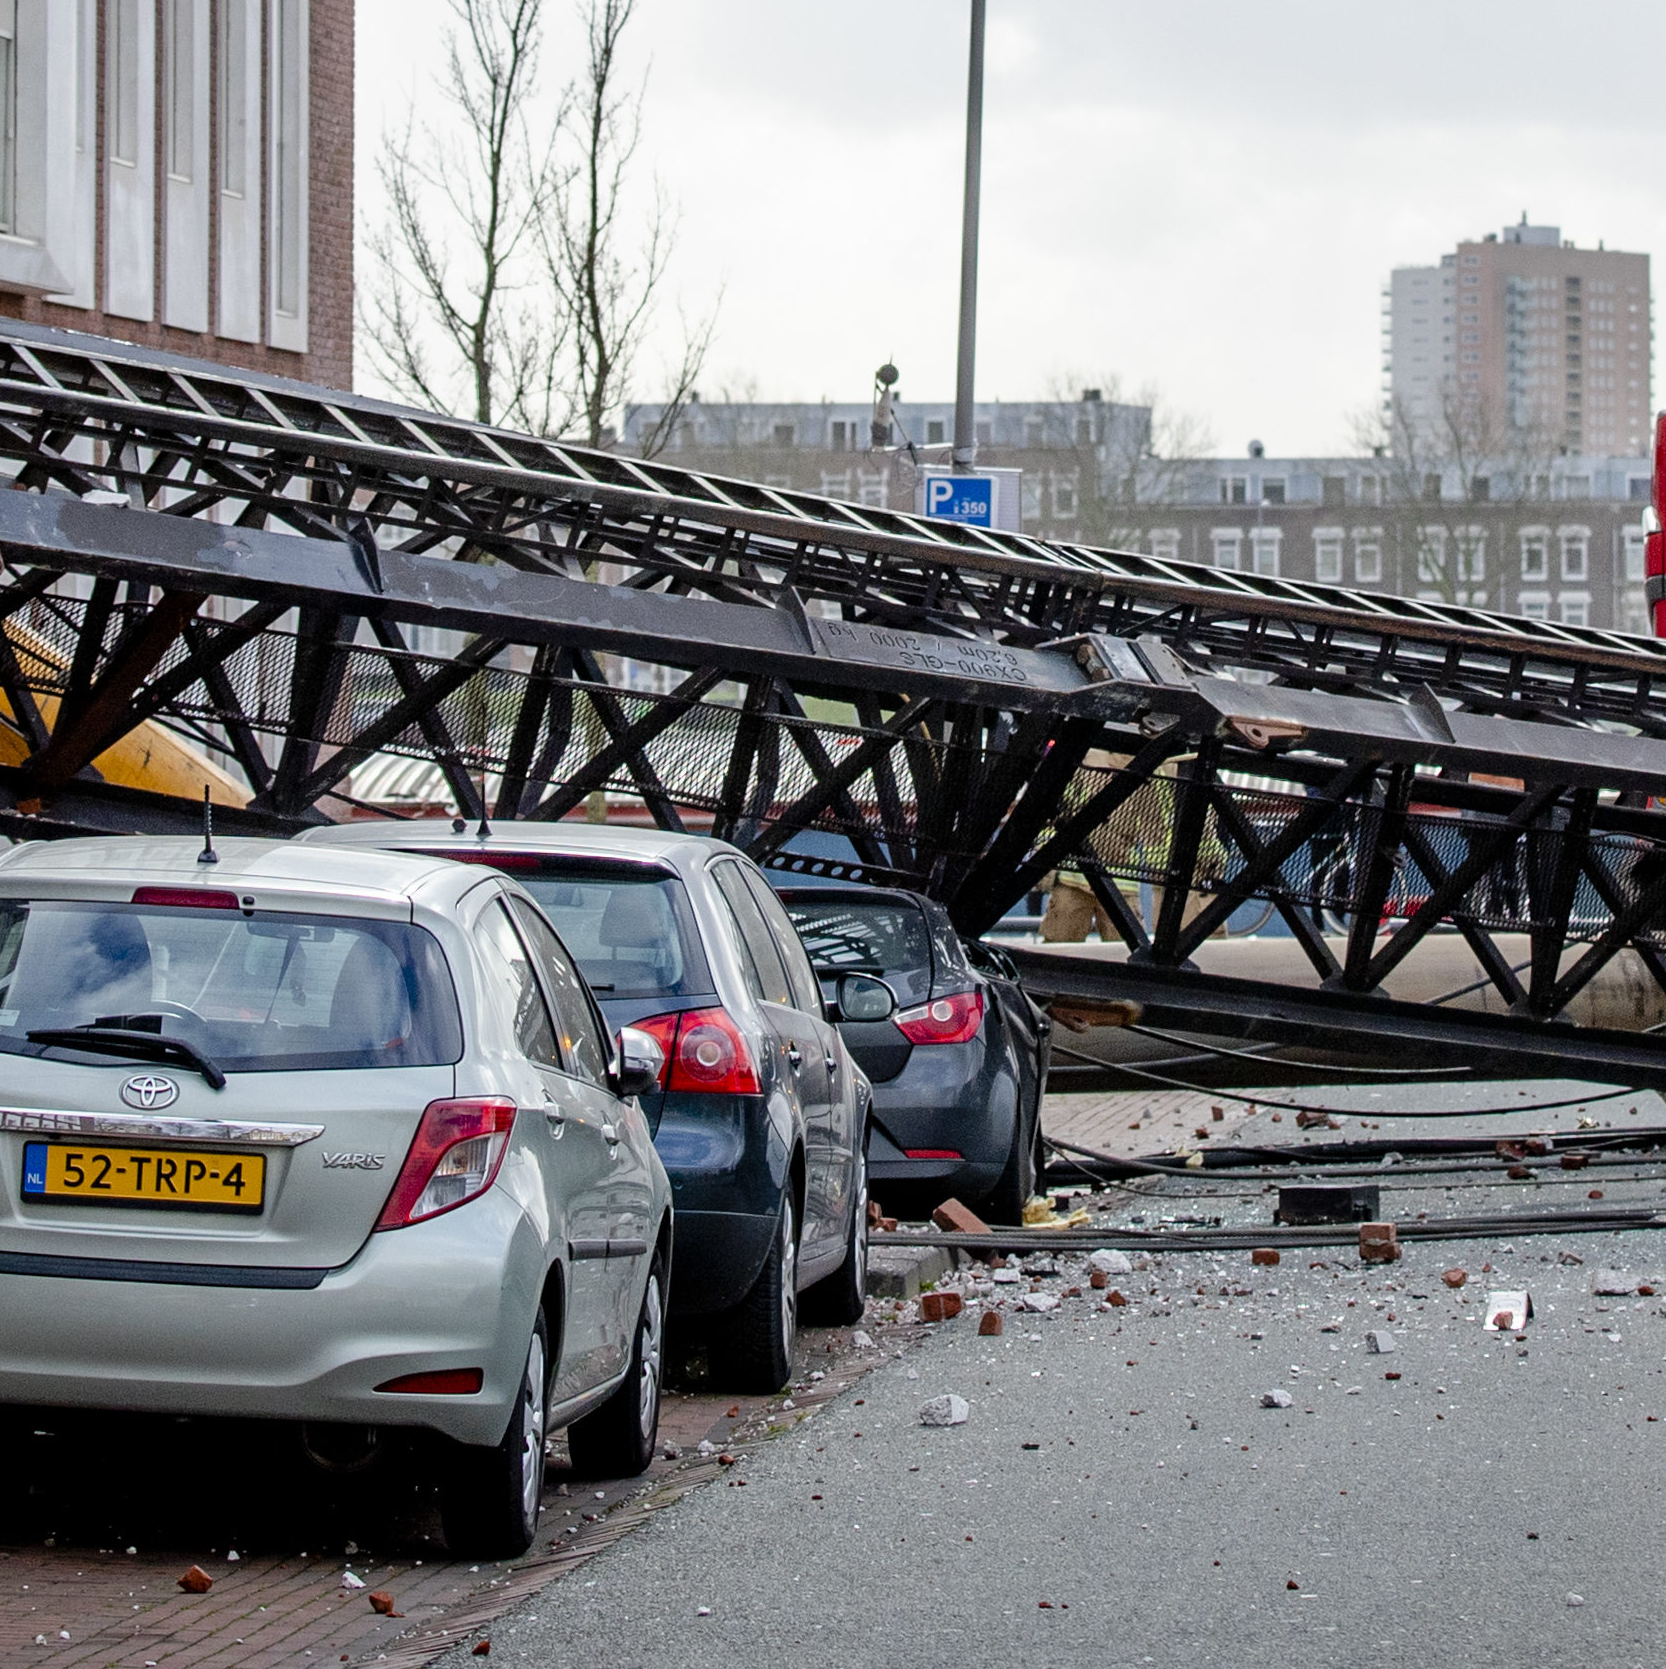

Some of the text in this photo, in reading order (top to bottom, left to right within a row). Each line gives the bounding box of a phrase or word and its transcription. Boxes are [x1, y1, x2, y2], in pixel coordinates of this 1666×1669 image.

[929, 480, 953, 513] P
[961, 501, 987, 514] 350
[870, 632, 921, 651] 2000
[899, 651, 1027, 682] CX900-GLS
[27, 1153, 246, 1196] NL 52-TRP-4
